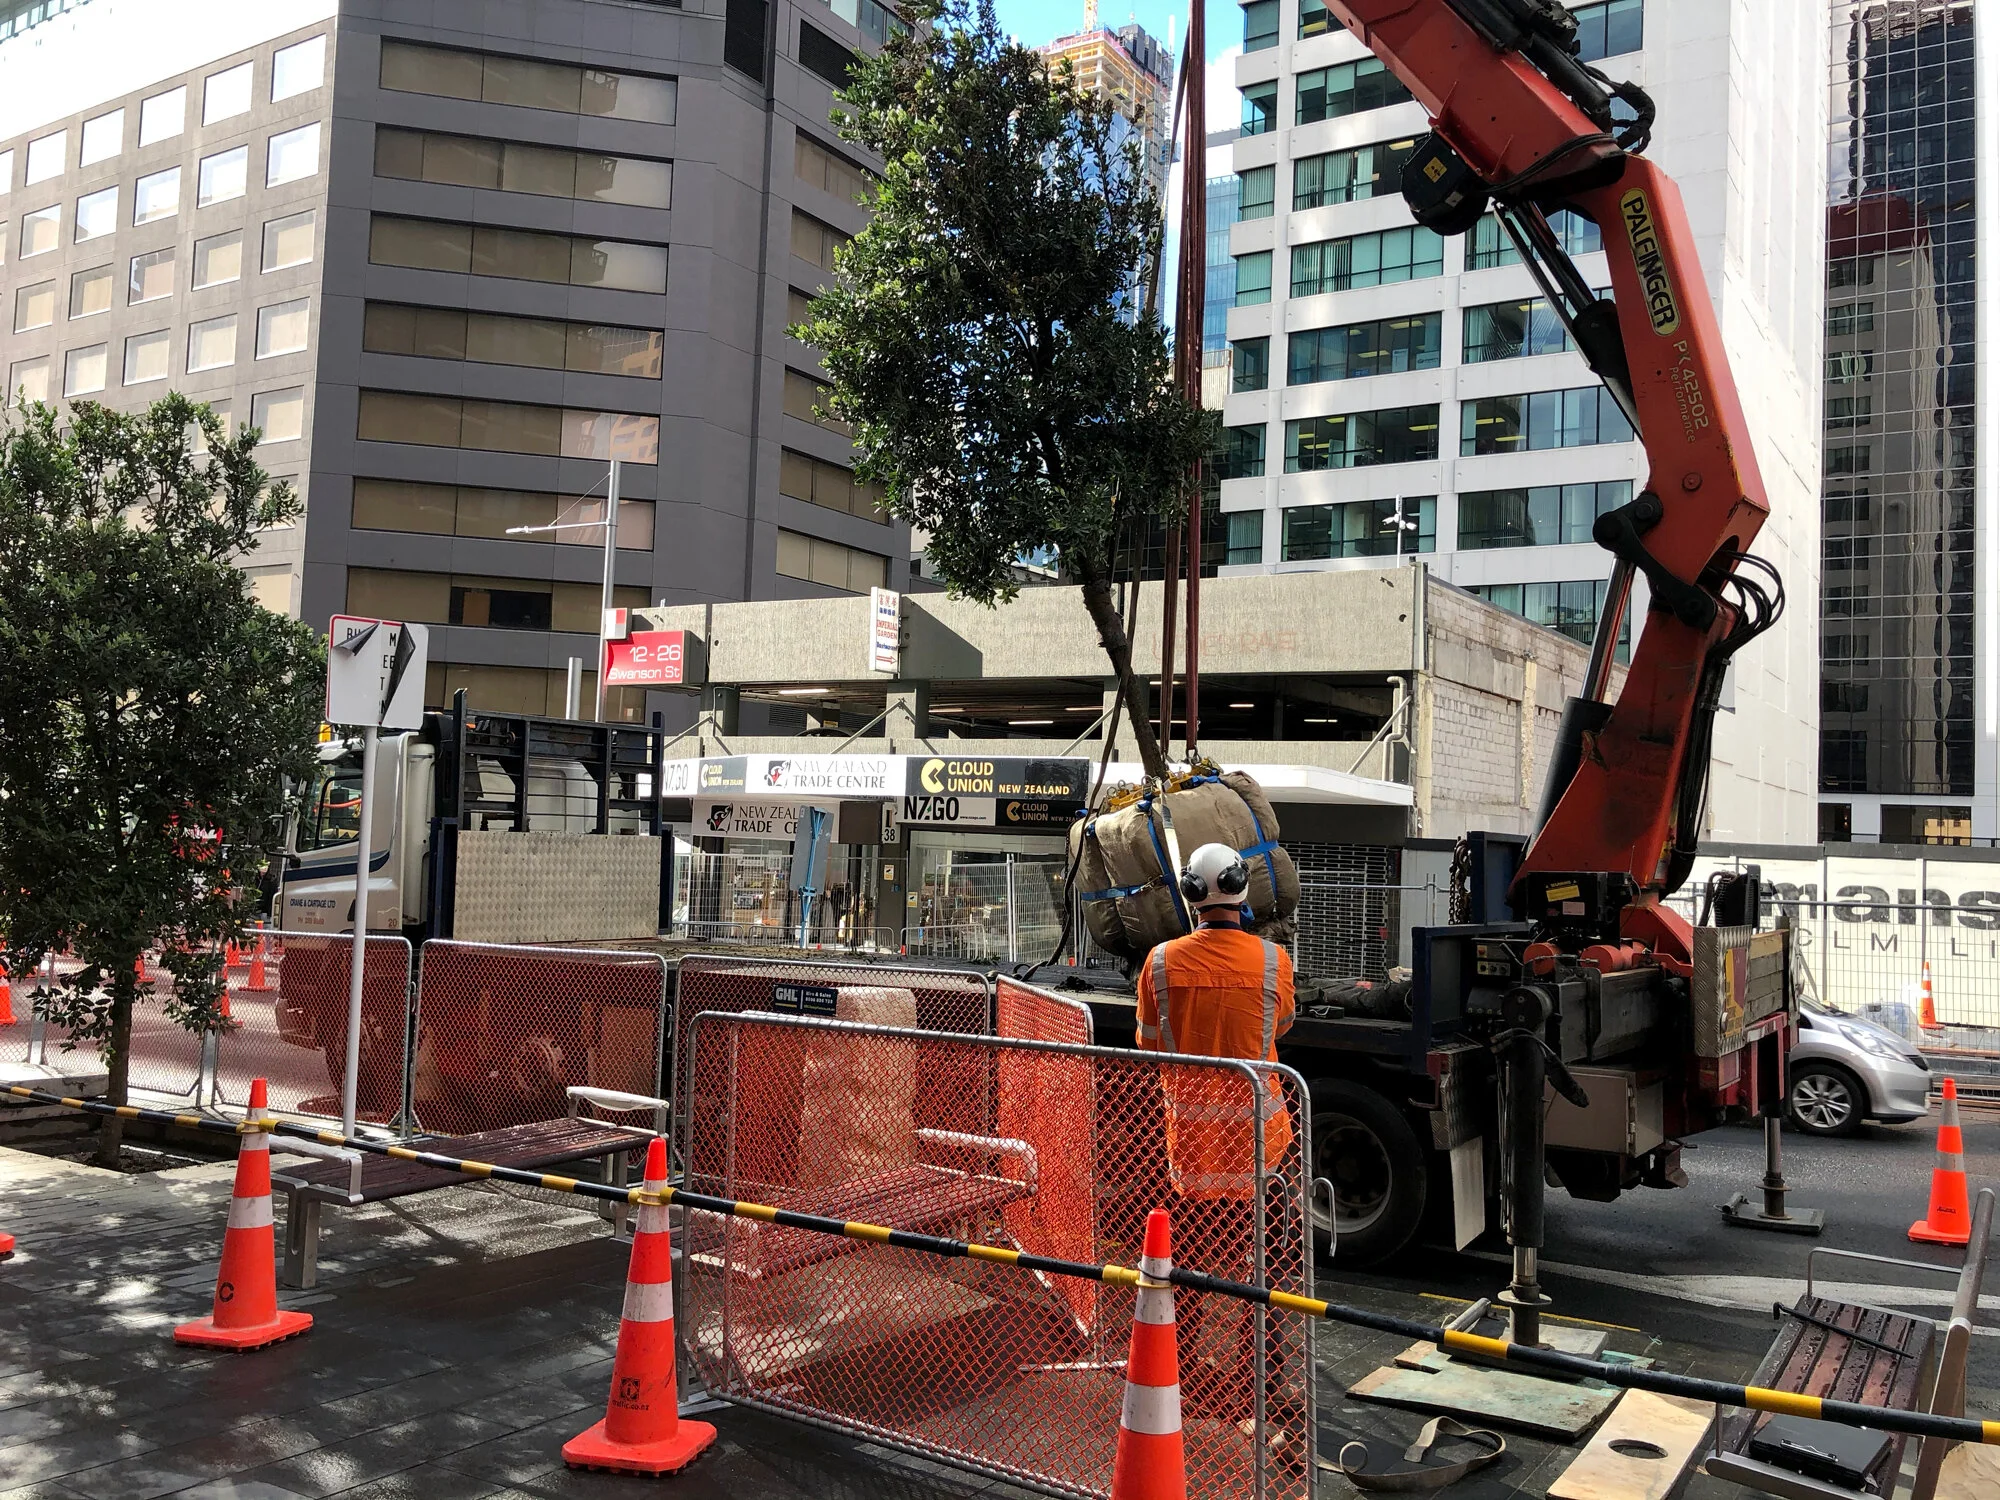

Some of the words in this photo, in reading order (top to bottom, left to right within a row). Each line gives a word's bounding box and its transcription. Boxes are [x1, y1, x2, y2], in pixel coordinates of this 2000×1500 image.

[1622, 196, 1676, 329] PALFINGER
[1673, 340, 1692, 366] PK
[1669, 366, 1696, 444] Performance
[1682, 368, 1710, 430] 42502
[876, 620, 898, 632] IMPERIAL
[877, 630, 898, 640] GARDEN
[608, 667, 662, 680] Swanson
[664, 665, 681, 678] St
[948, 761, 994, 776] CLOUD
[793, 775, 833, 788] TRADE
[837, 775, 886, 788] CENTRE
[948, 778, 993, 793] UNION
[999, 784, 1021, 795] NEW
[1024, 785, 1069, 795] ZEALAND
[739, 806, 766, 818] NEW
[904, 796, 960, 821] NZGO
[1022, 803, 1049, 811] CLOUD
[1022, 813, 1048, 821] UNION
[735, 820, 773, 833] TRADE
[884, 829, 896, 842] 38
[290, 899, 303, 907] CRANE
[308, 900, 327, 908] CARTAGE
[327, 900, 336, 908] LTD
[388, 918, 398, 928] 20
[775, 987, 798, 1002] GHL
[219, 1281, 234, 1302] C
